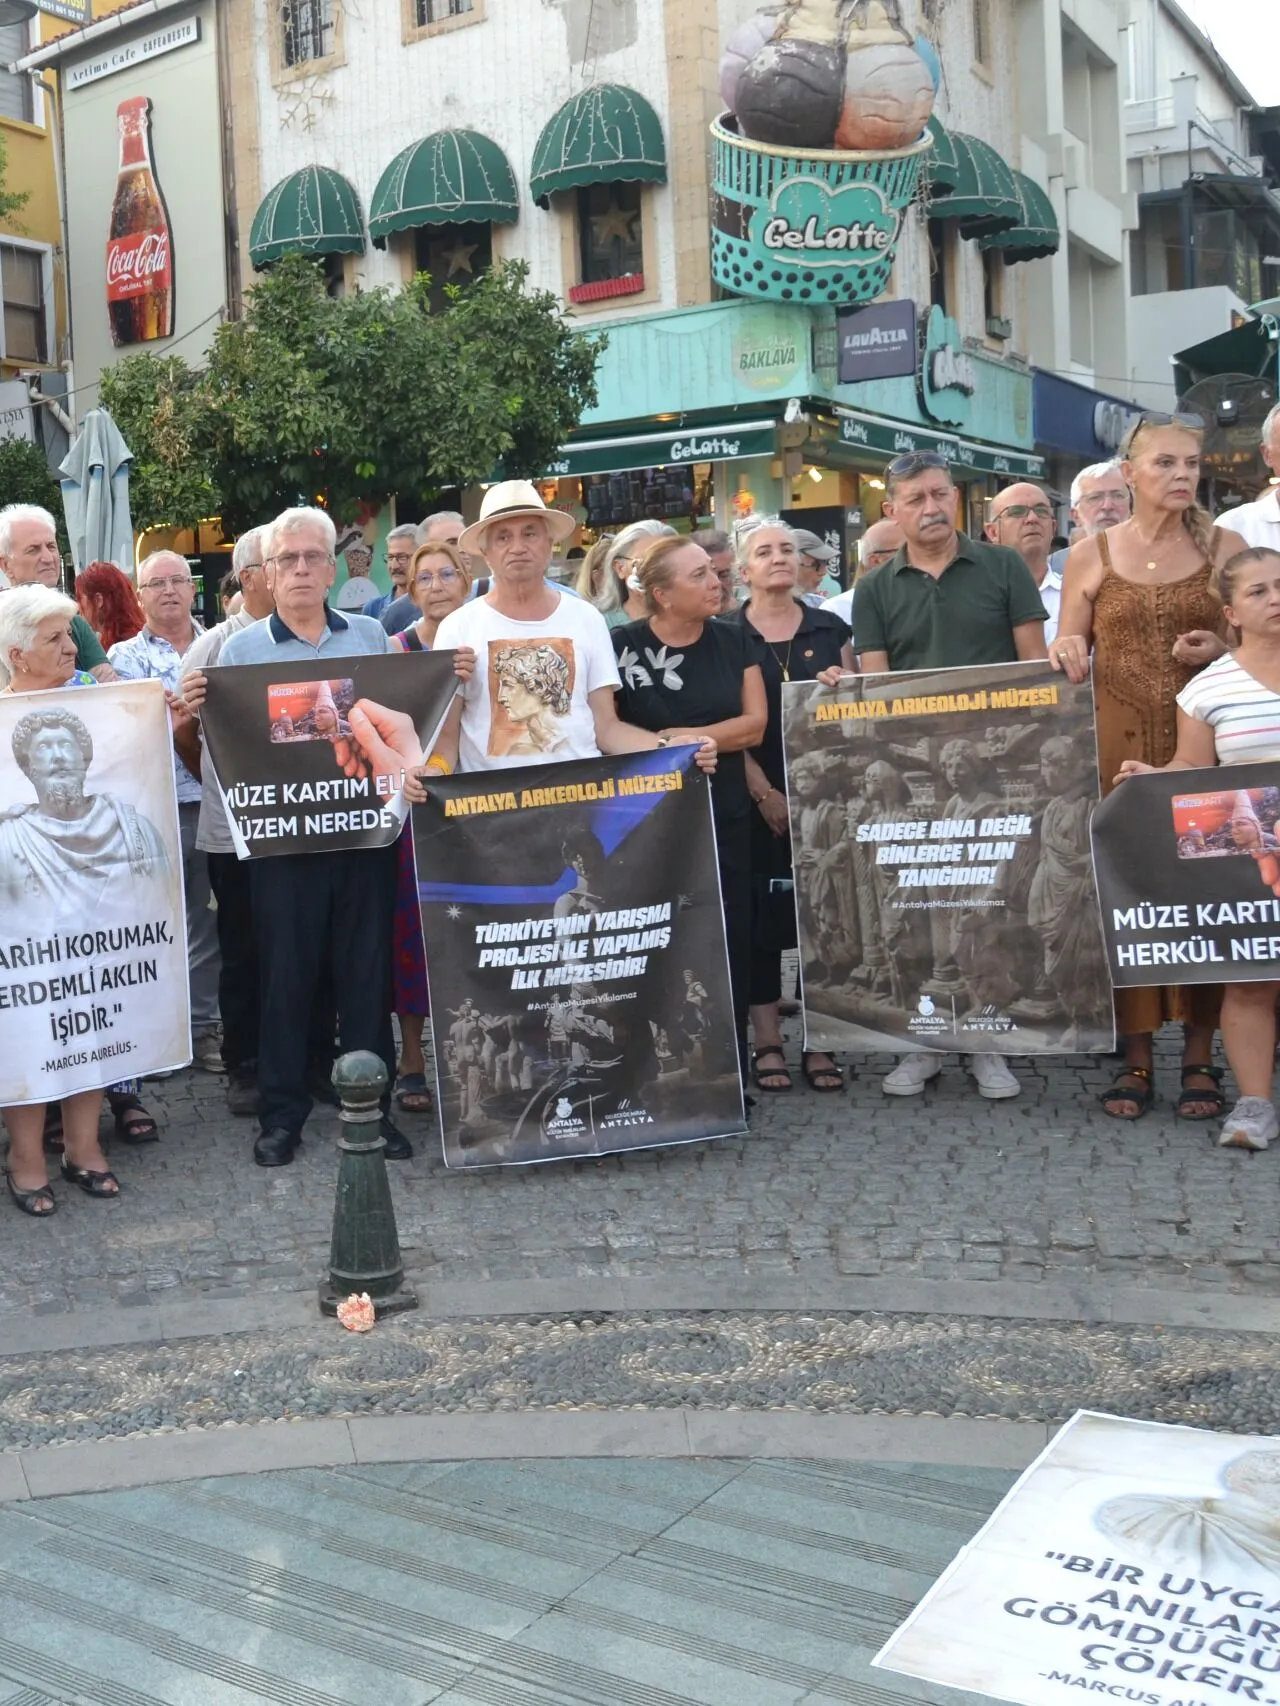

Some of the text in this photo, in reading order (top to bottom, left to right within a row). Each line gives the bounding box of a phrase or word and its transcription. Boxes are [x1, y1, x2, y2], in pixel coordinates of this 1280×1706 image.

[111, 48, 136, 66] Cafe
[764, 217, 889, 249] GeLatte
[107, 232, 167, 285] Coca-Cola
[844, 327, 908, 349] LAVAZZA
[740, 348, 795, 369] BAKLAVA
[671, 438, 738, 460] GeLatte
[816, 685, 1058, 721] ANTALYA ARKEOLOJİ MÜZESİ
[283, 777, 369, 805] KARTIM
[445, 770, 683, 817] ANTALYA ARKEOLOJİ MÜZESİ
[305, 808, 393, 834] NEREDE
[856, 814, 1033, 843] SADECE BİNA DEĞİL
[876, 841, 1016, 865] BİNLERCE YILIN
[897, 866, 998, 889] TANIĞIDIR!
[475, 902, 671, 945] TÜRKİYE'NİN YARIŞMA
[1113, 899, 1280, 931] MÜZE KARTI
[65, 920, 174, 960] KORUMAK,
[478, 926, 672, 968] PROJESİ İLE YAPILMIŞ
[1116, 934, 1225, 967] HERKÜL
[100, 959, 158, 991] AKLIN
[510, 956, 648, 990] İLK MÜZESİDİR!
[49, 1003, 122, 1046] İŞİDİR."
[909, 1017, 946, 1025] ANTALYA
[547, 1118, 583, 1129] ANTALYA
[600, 1116, 654, 1129] ANTALYA
[1045, 1550, 1144, 1586] "BİR
[1086, 1589, 1280, 1644] ANILAR
[1038, 1670, 1161, 1705] -MARCUS
